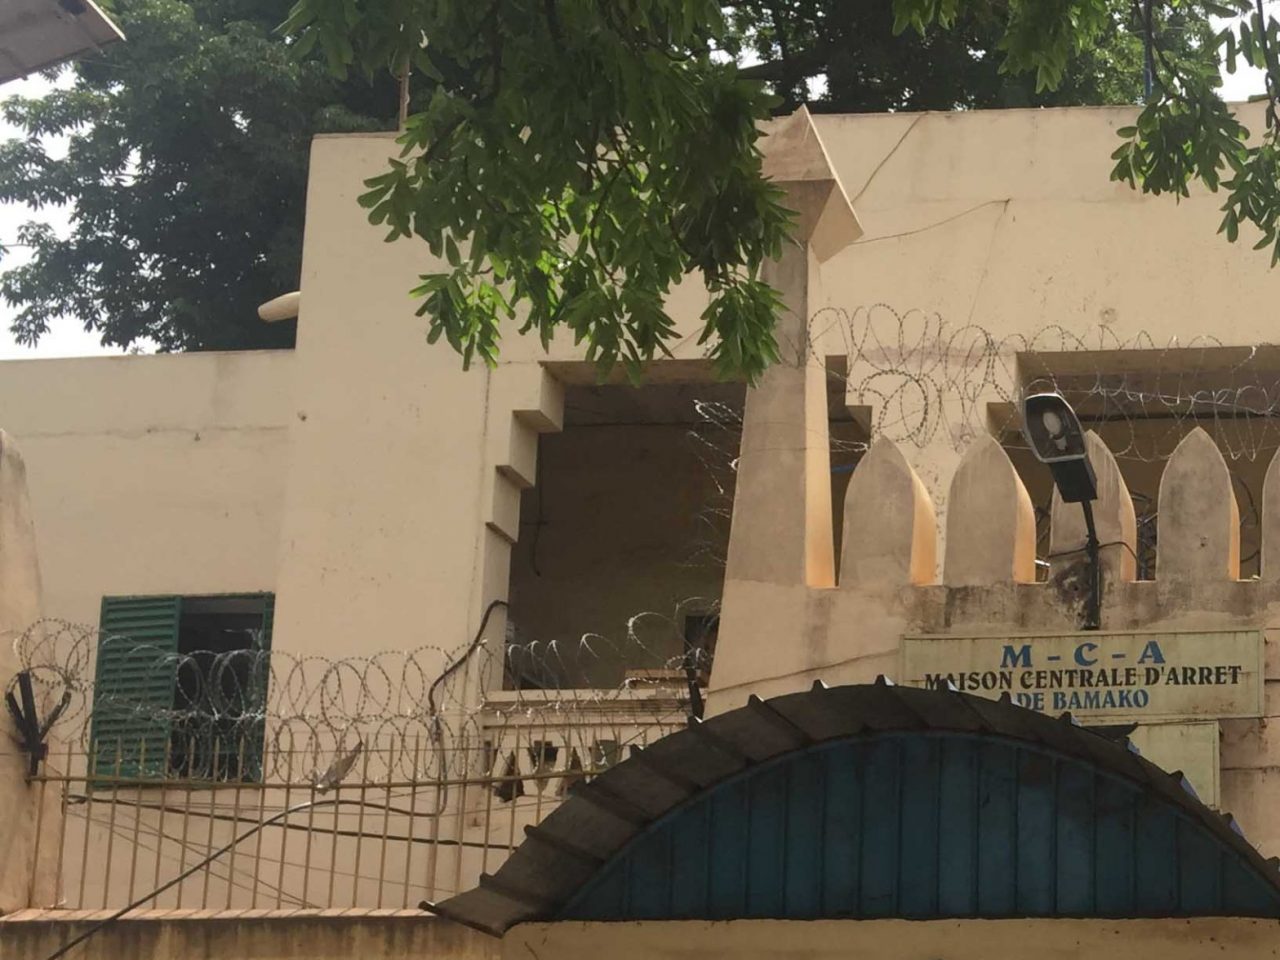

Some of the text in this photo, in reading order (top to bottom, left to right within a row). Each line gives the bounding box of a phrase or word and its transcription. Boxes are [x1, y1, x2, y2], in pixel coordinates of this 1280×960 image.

[1000, 645, 1033, 668] M
[1074, 643, 1098, 666] C
[1138, 640, 1166, 664] A
[925, 665, 1242, 690] MAISON CENTRALE D'ARRET
[1016, 689, 1149, 711] DE BAMAKO
